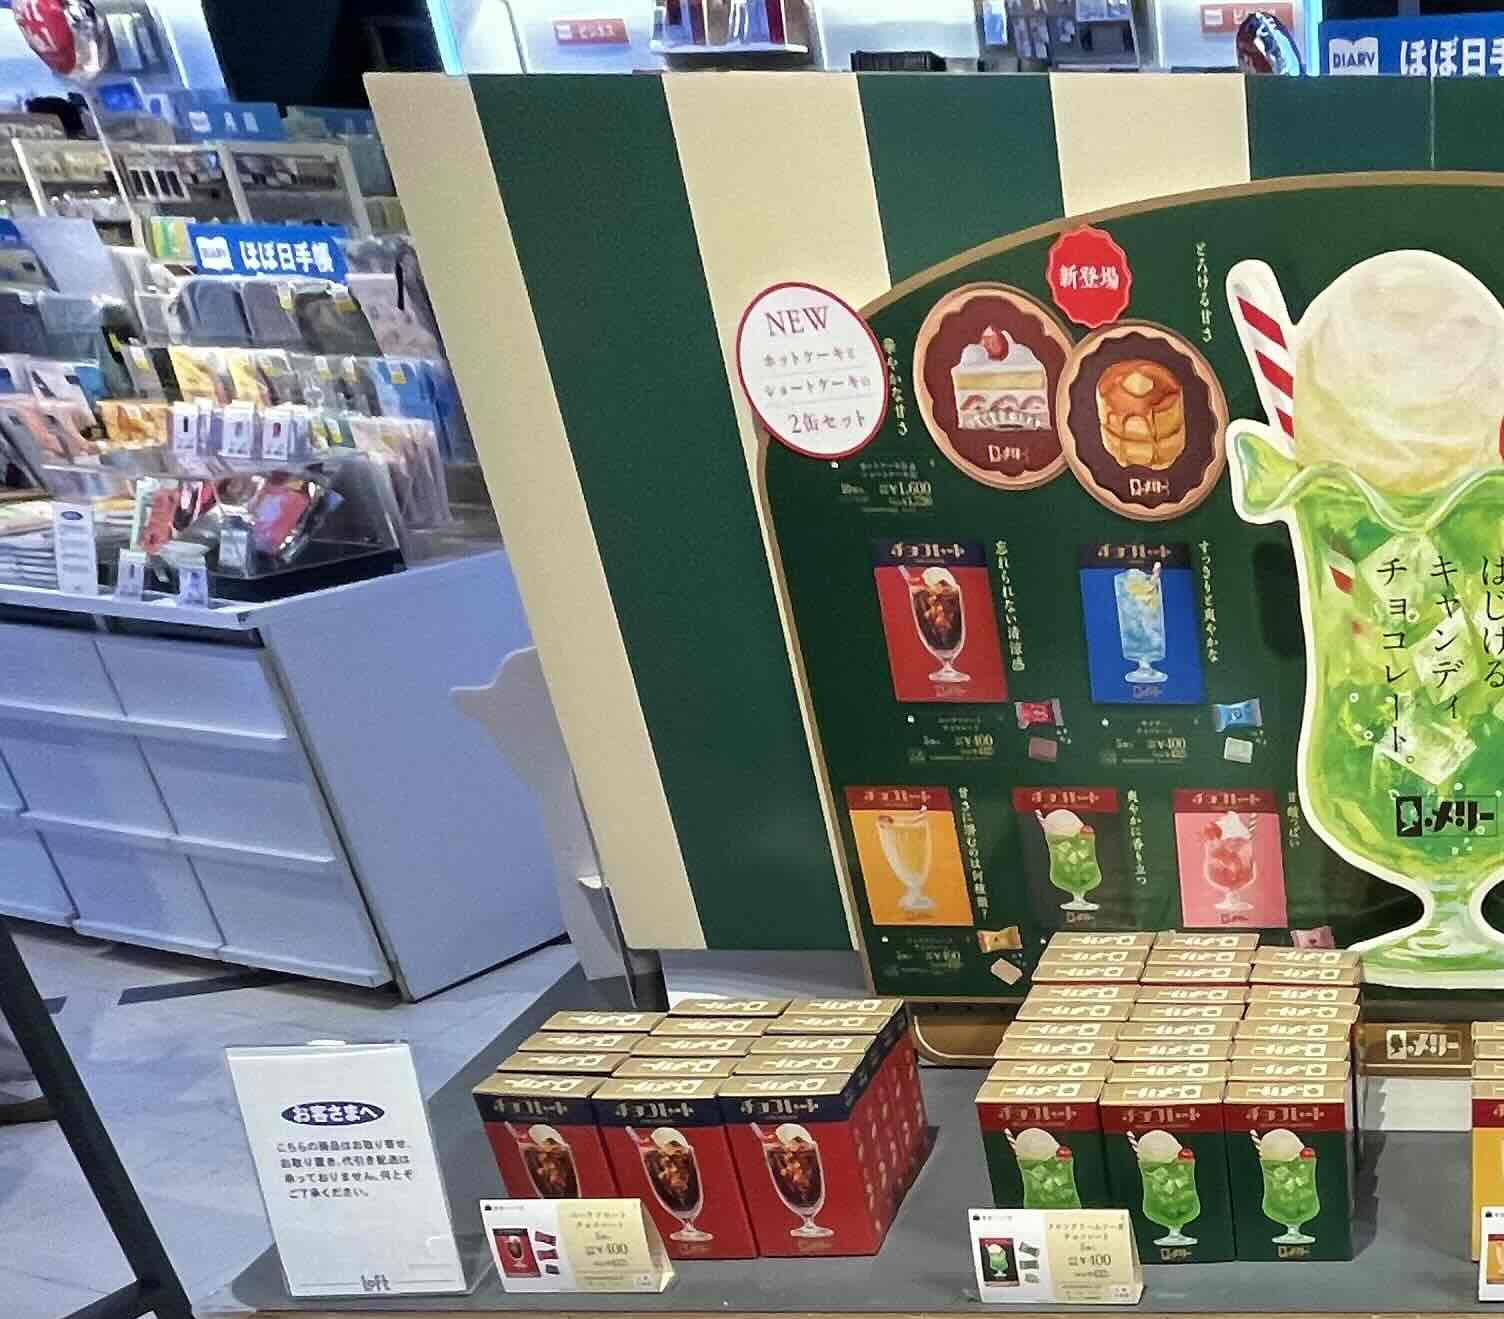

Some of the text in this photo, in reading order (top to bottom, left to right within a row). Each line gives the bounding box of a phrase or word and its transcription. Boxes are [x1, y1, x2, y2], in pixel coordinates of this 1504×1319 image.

[1332, 48, 1376, 69] DIARY
[239, 240, 334, 272] ほぼ日手帳
[1059, 264, 1119, 290] 新登場
[764, 305, 829, 337] NEW
[1430, 555, 1465, 720] キャンディ
[292, 1104, 379, 1123] お客さまへ
